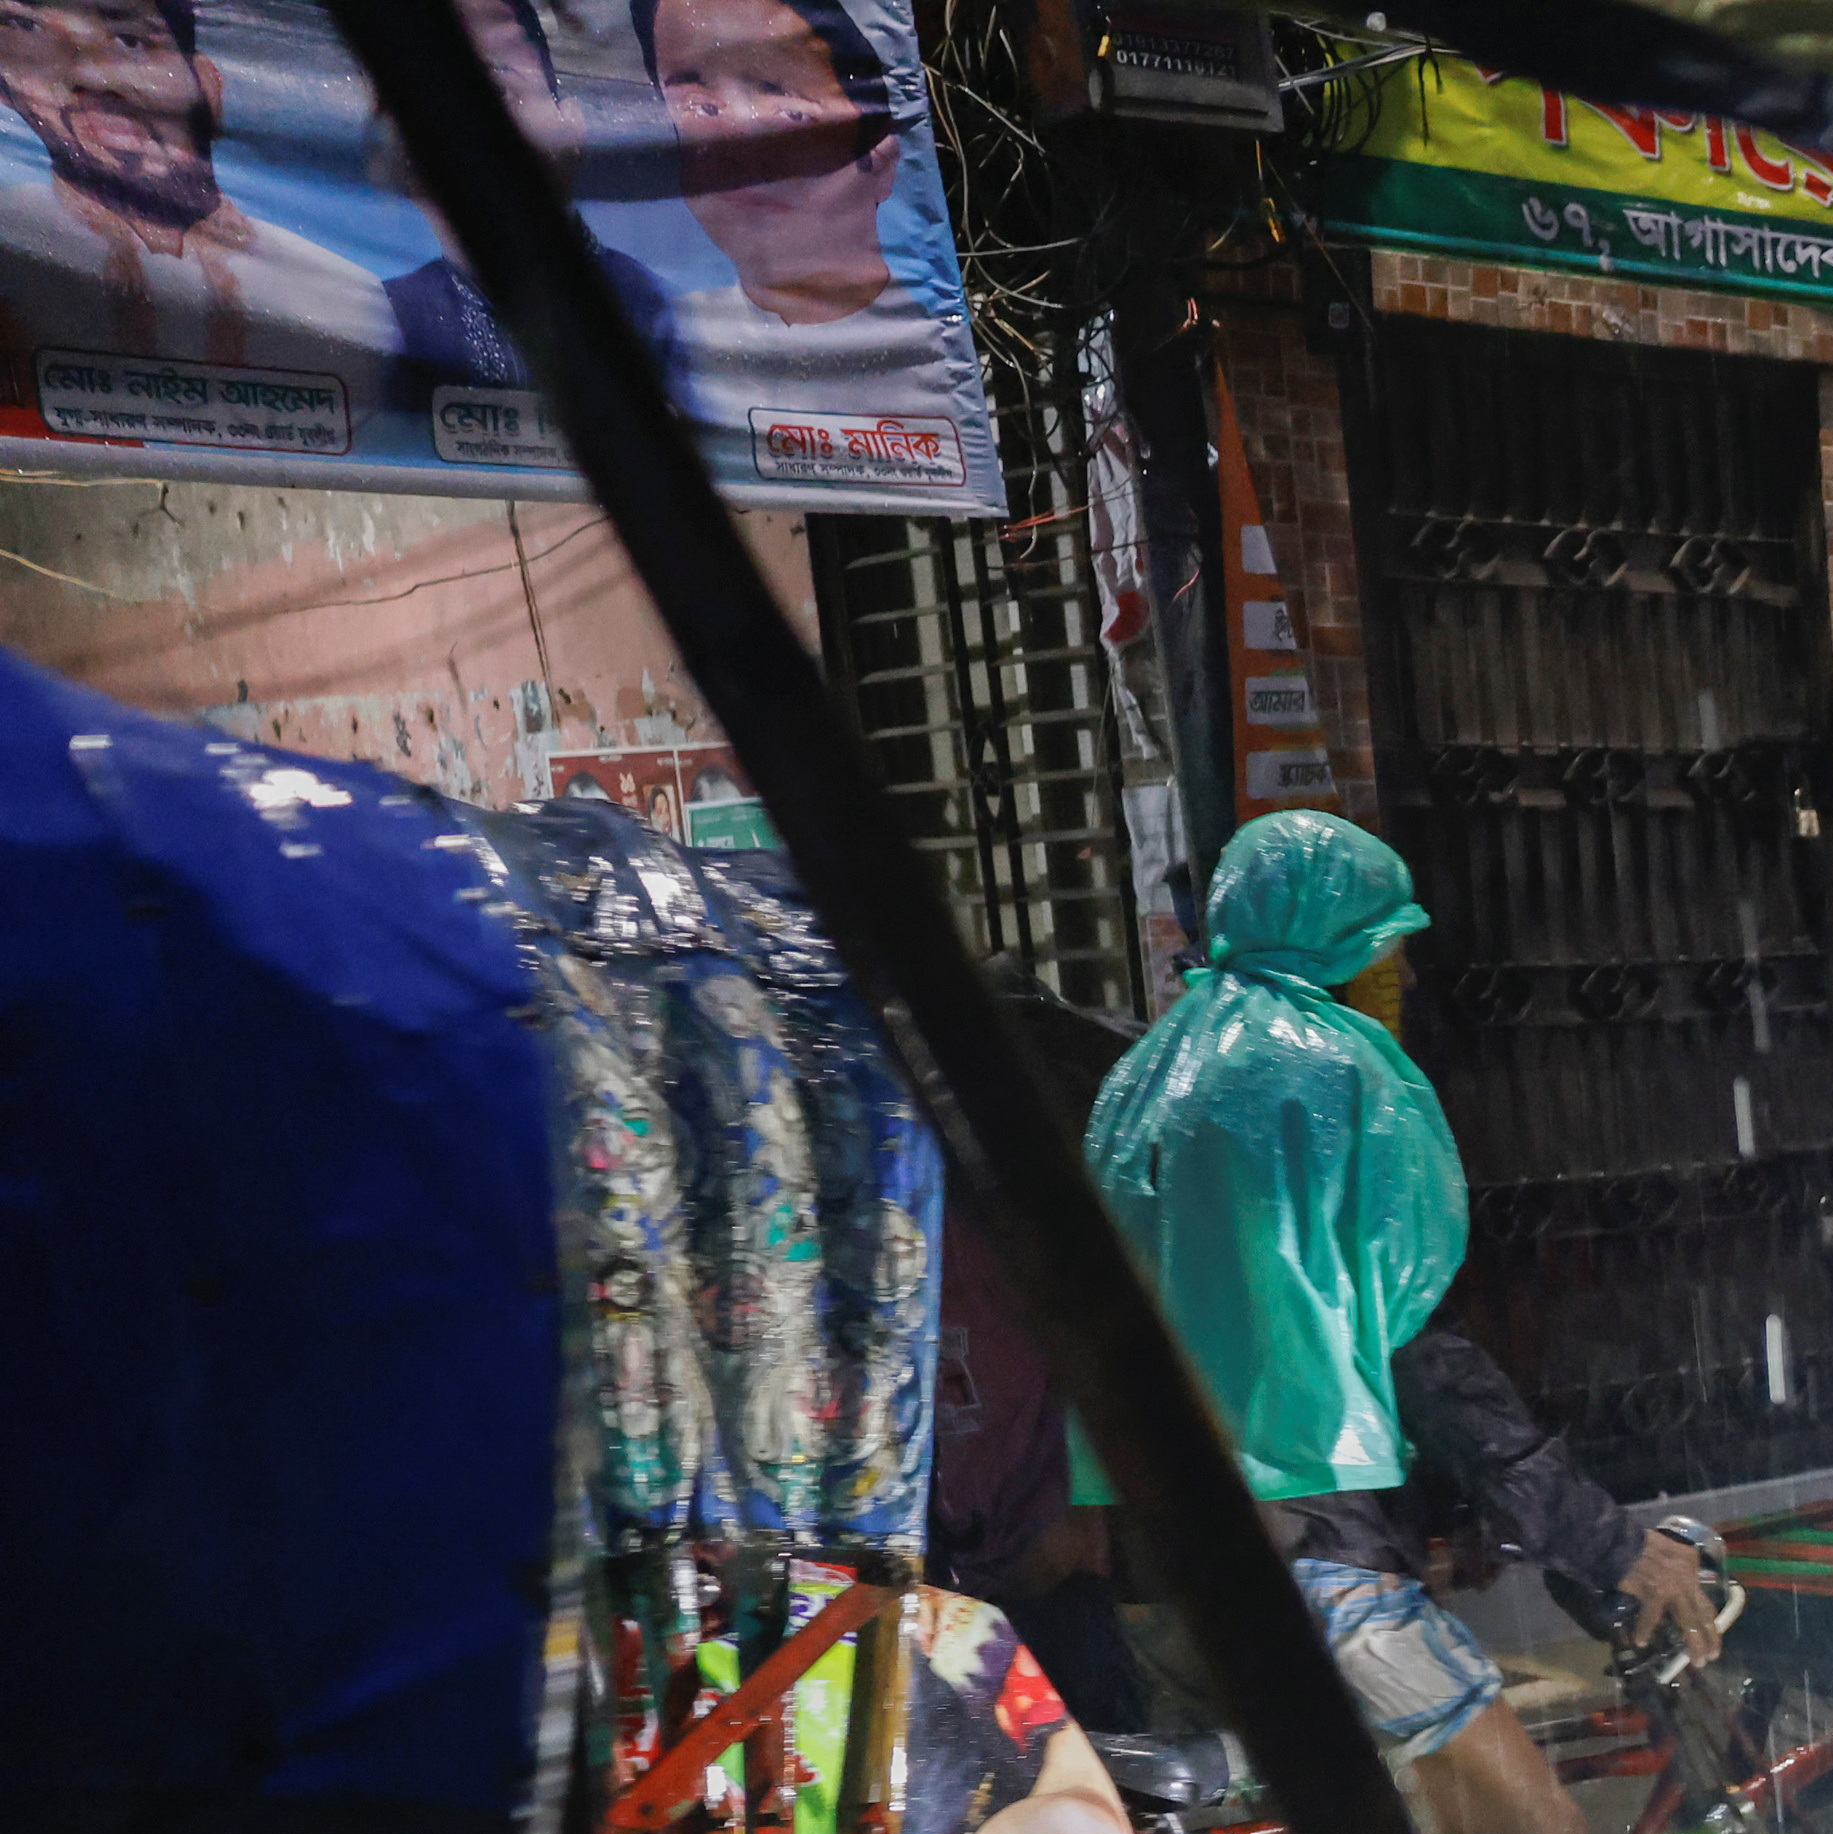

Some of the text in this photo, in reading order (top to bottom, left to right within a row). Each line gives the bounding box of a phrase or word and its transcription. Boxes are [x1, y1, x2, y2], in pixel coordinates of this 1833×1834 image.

[440, 401, 520, 434] মোঃ
[767, 420, 942, 463] মোঃ মানিক
